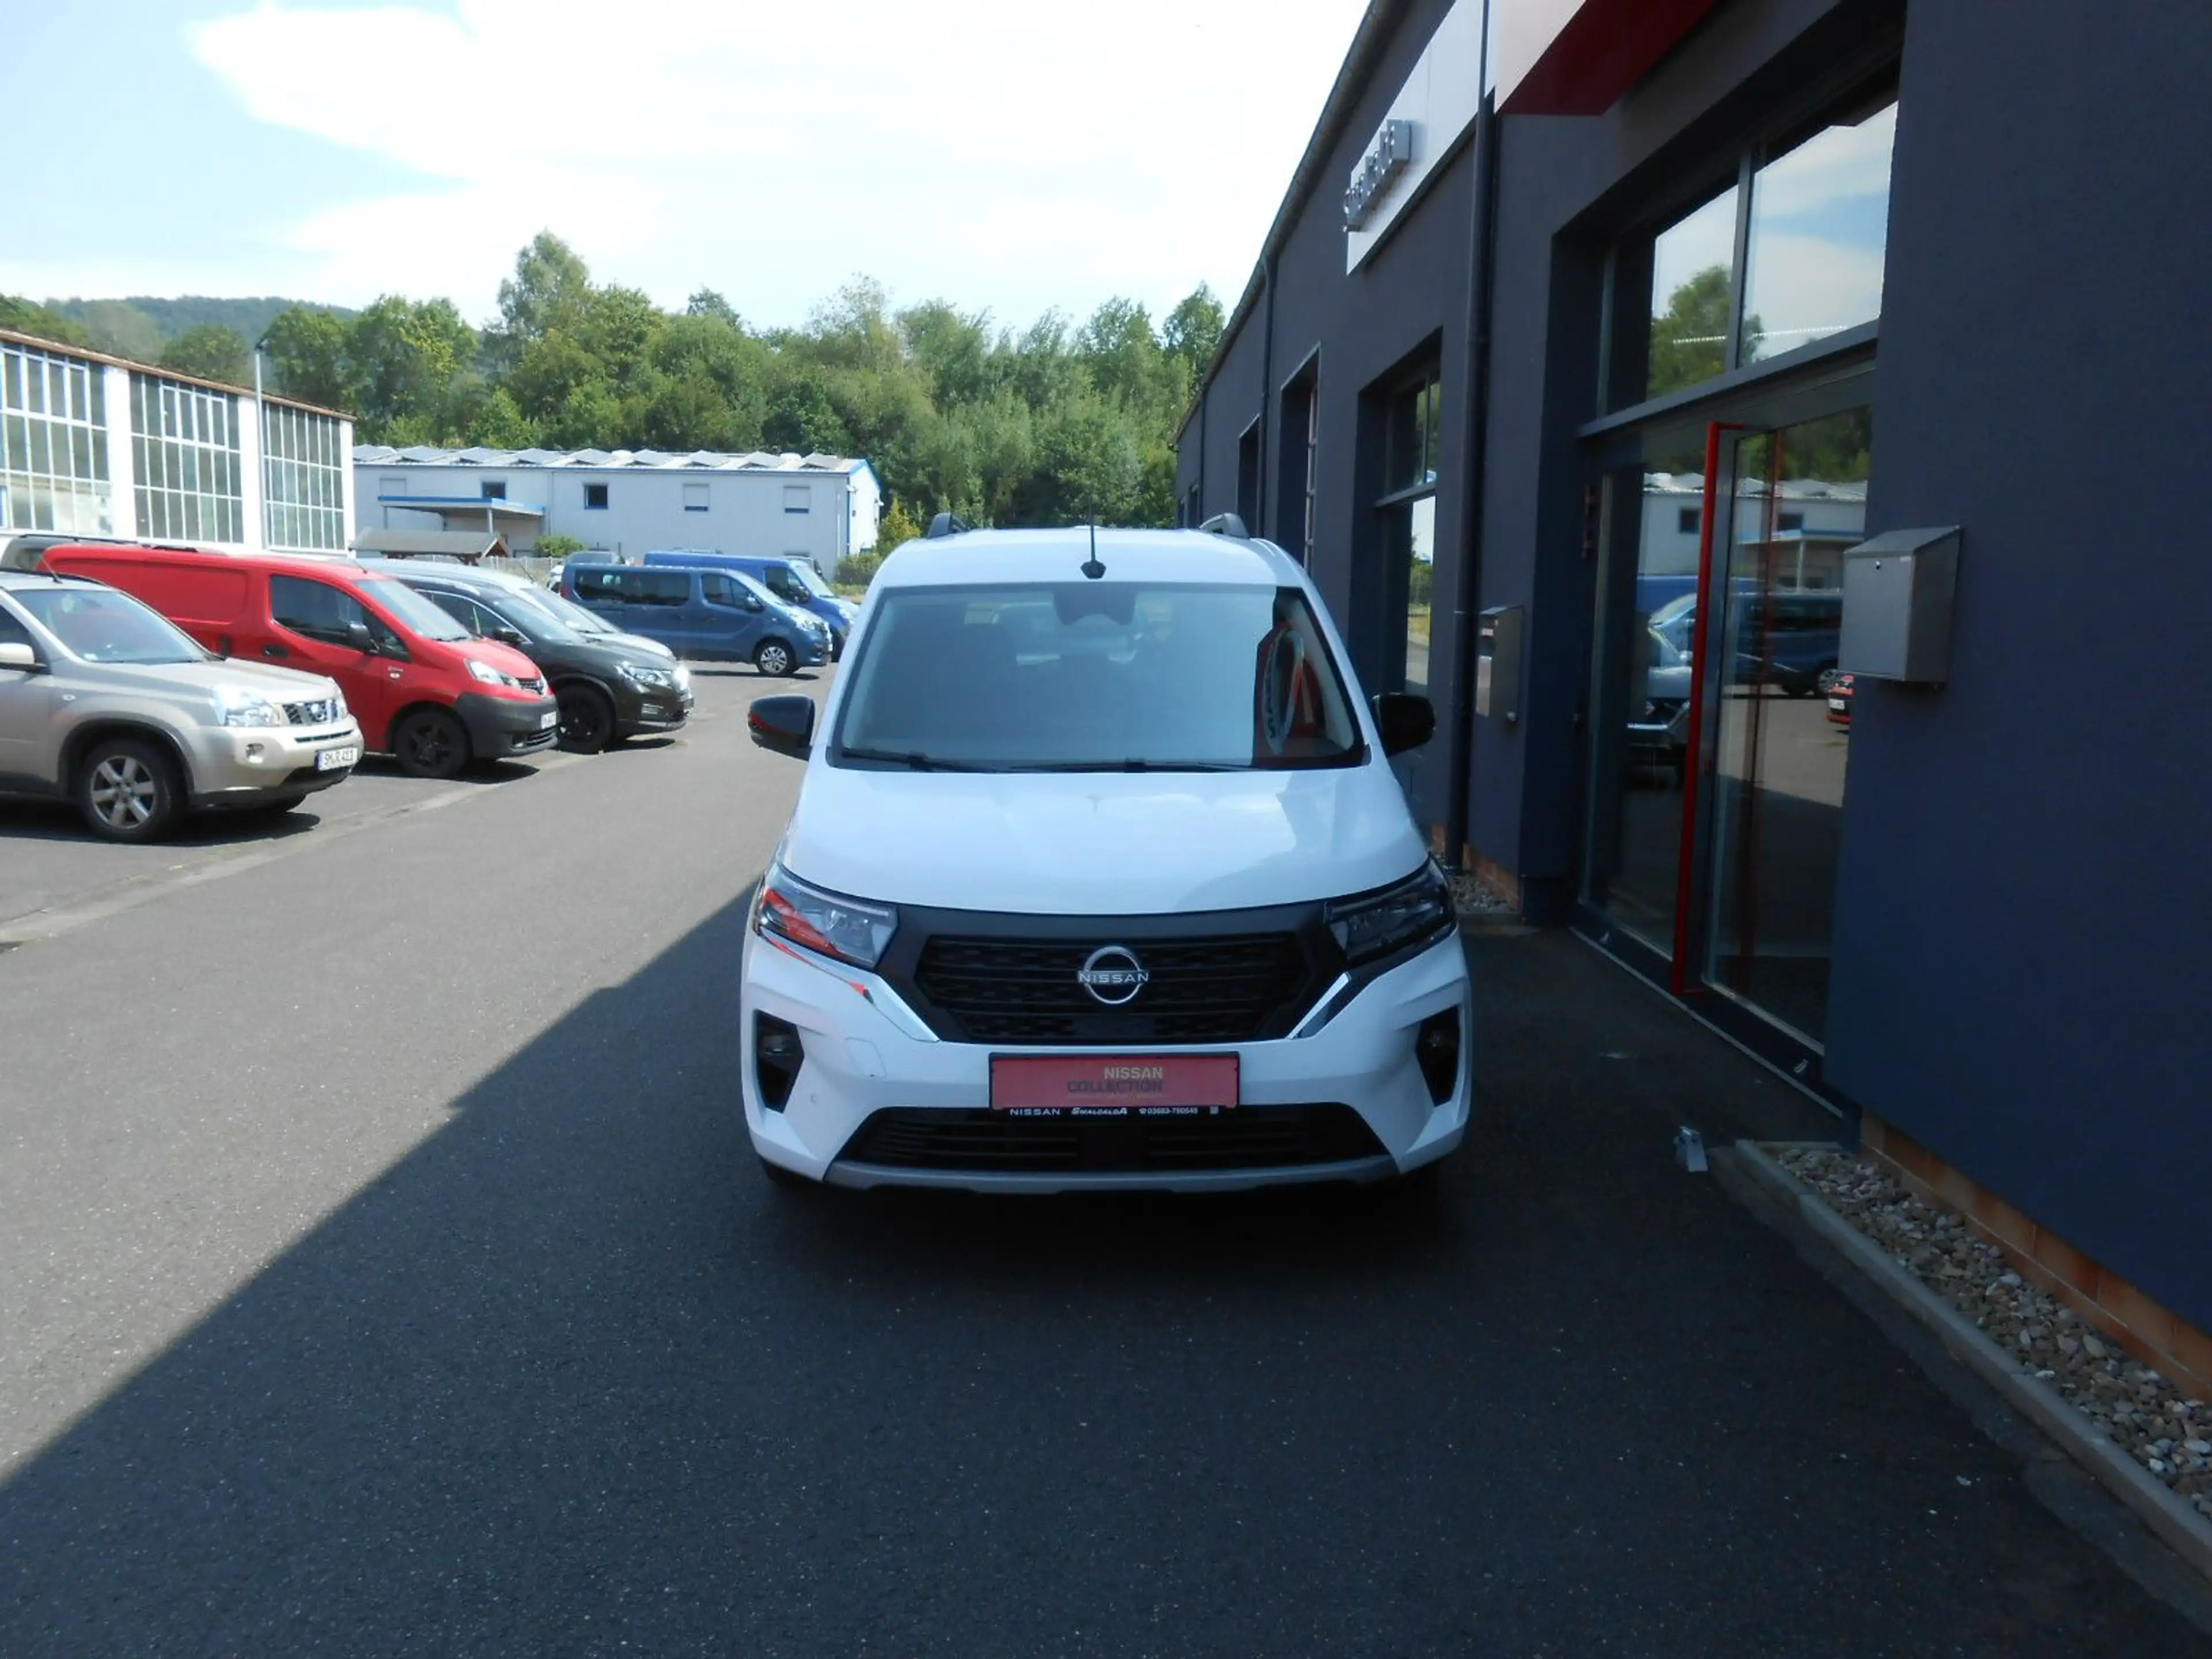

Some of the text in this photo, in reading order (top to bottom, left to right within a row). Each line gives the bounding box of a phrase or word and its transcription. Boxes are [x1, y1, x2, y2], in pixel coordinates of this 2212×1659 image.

[1078, 972, 1149, 983] NISSAN
[1104, 1067, 1163, 1080] NISSAN
[1067, 1080, 1163, 1093] COLLECTION
[1010, 1108, 1060, 1116] NISSAN
